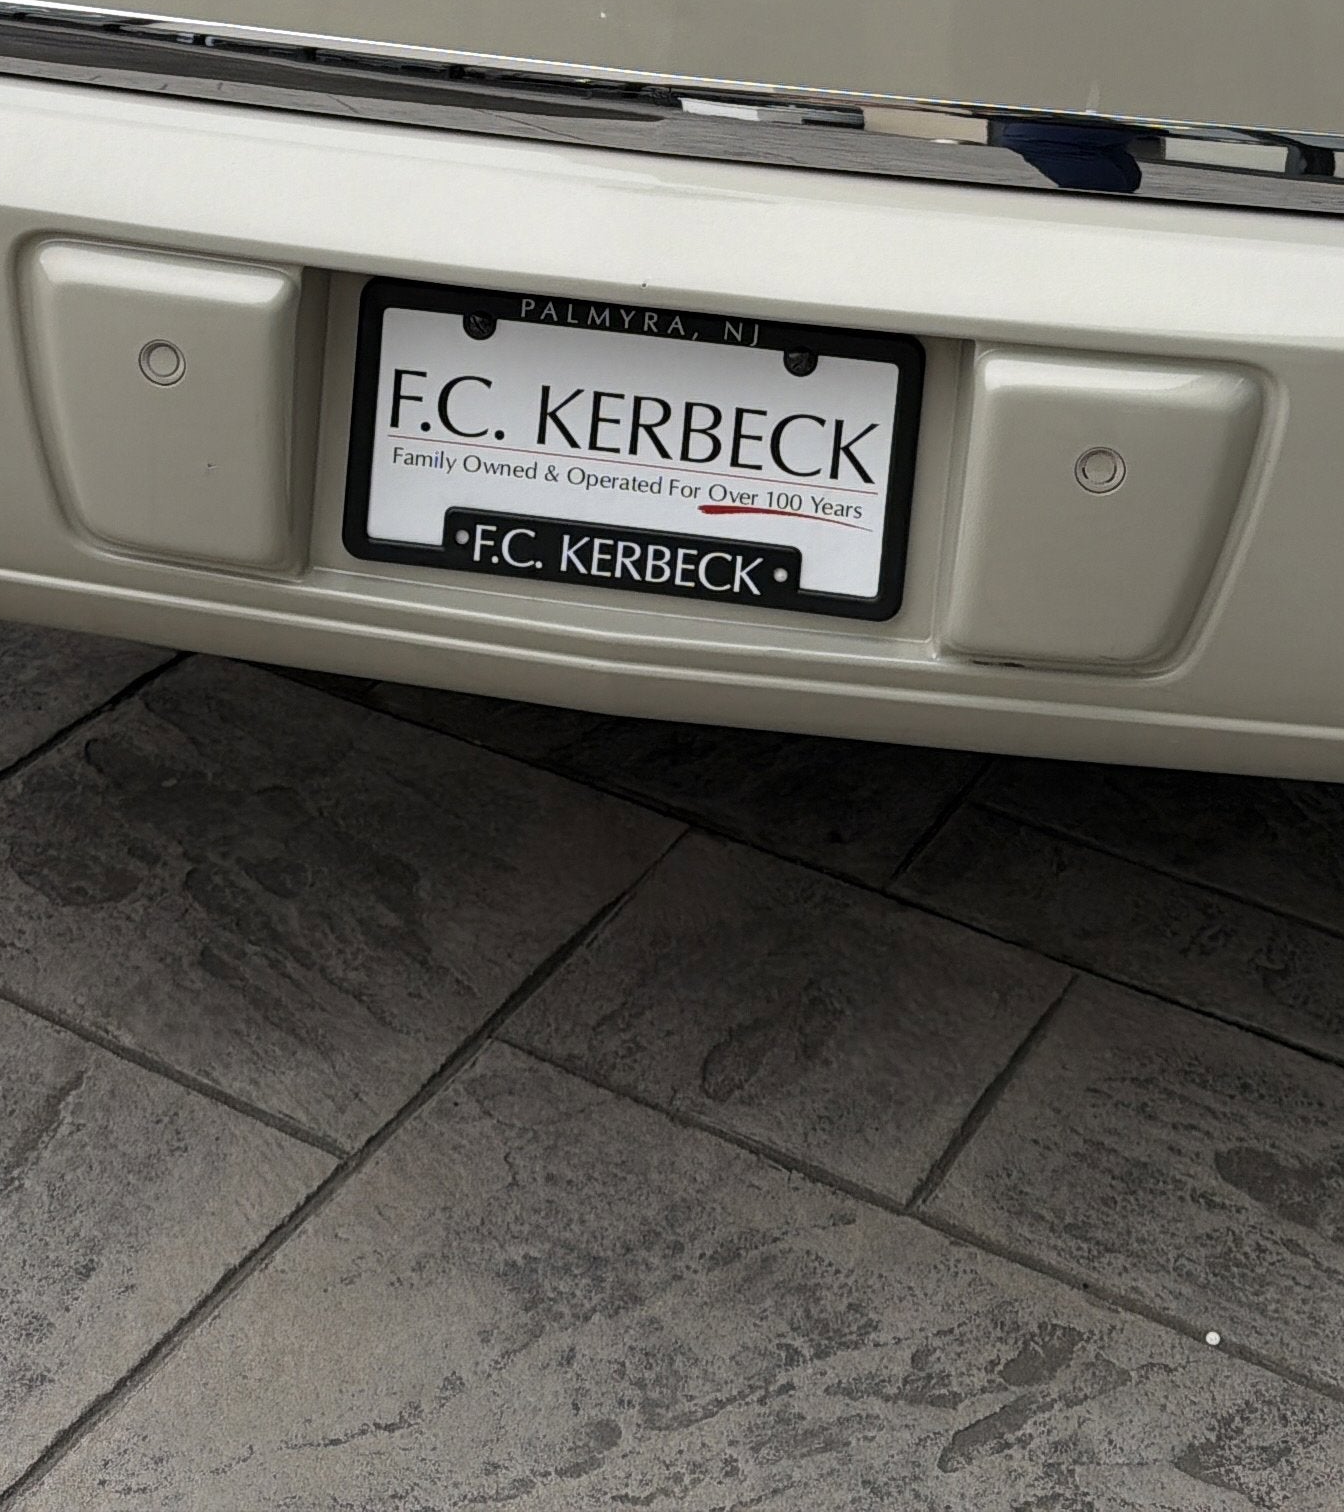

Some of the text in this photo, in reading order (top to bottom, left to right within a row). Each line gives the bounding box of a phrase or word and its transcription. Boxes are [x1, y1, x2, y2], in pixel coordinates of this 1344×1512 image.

[520, 298, 760, 347] PALMYRA, NJ
[389, 368, 881, 485] F.C. KERBECK
[393, 446, 863, 520] Family Owned & Operated For Over 100 Years
[472, 523, 764, 596] F.C. KERBECK
